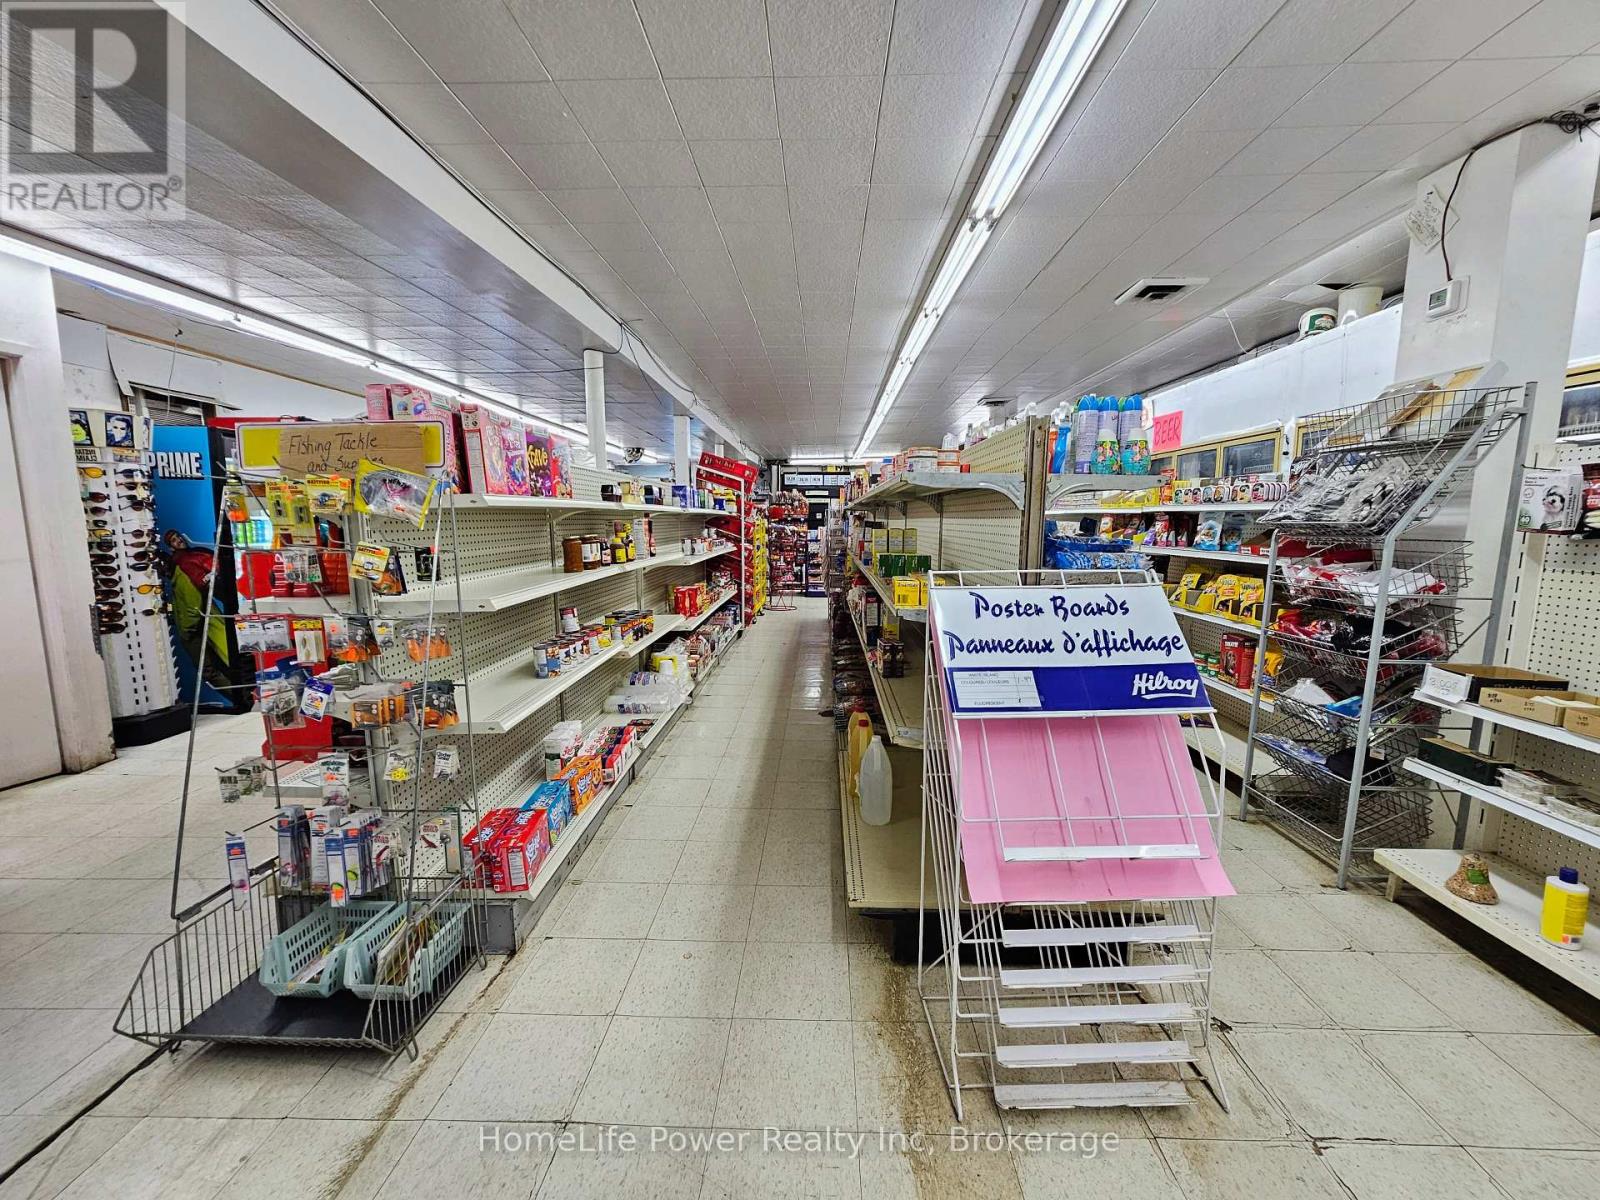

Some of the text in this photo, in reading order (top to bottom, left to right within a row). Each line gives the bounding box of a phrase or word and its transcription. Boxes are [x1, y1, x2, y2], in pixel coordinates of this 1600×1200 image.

[1154, 415, 1181, 446] BEER
[288, 431, 379, 460] Fishing Tackle
[147, 451, 205, 480] PRIME
[307, 455, 328, 473] and
[968, 590, 1130, 622] Poster Boards
[943, 628, 1184, 660] Panneaux d'affichage
[1131, 671, 1199, 700] Hilroy
